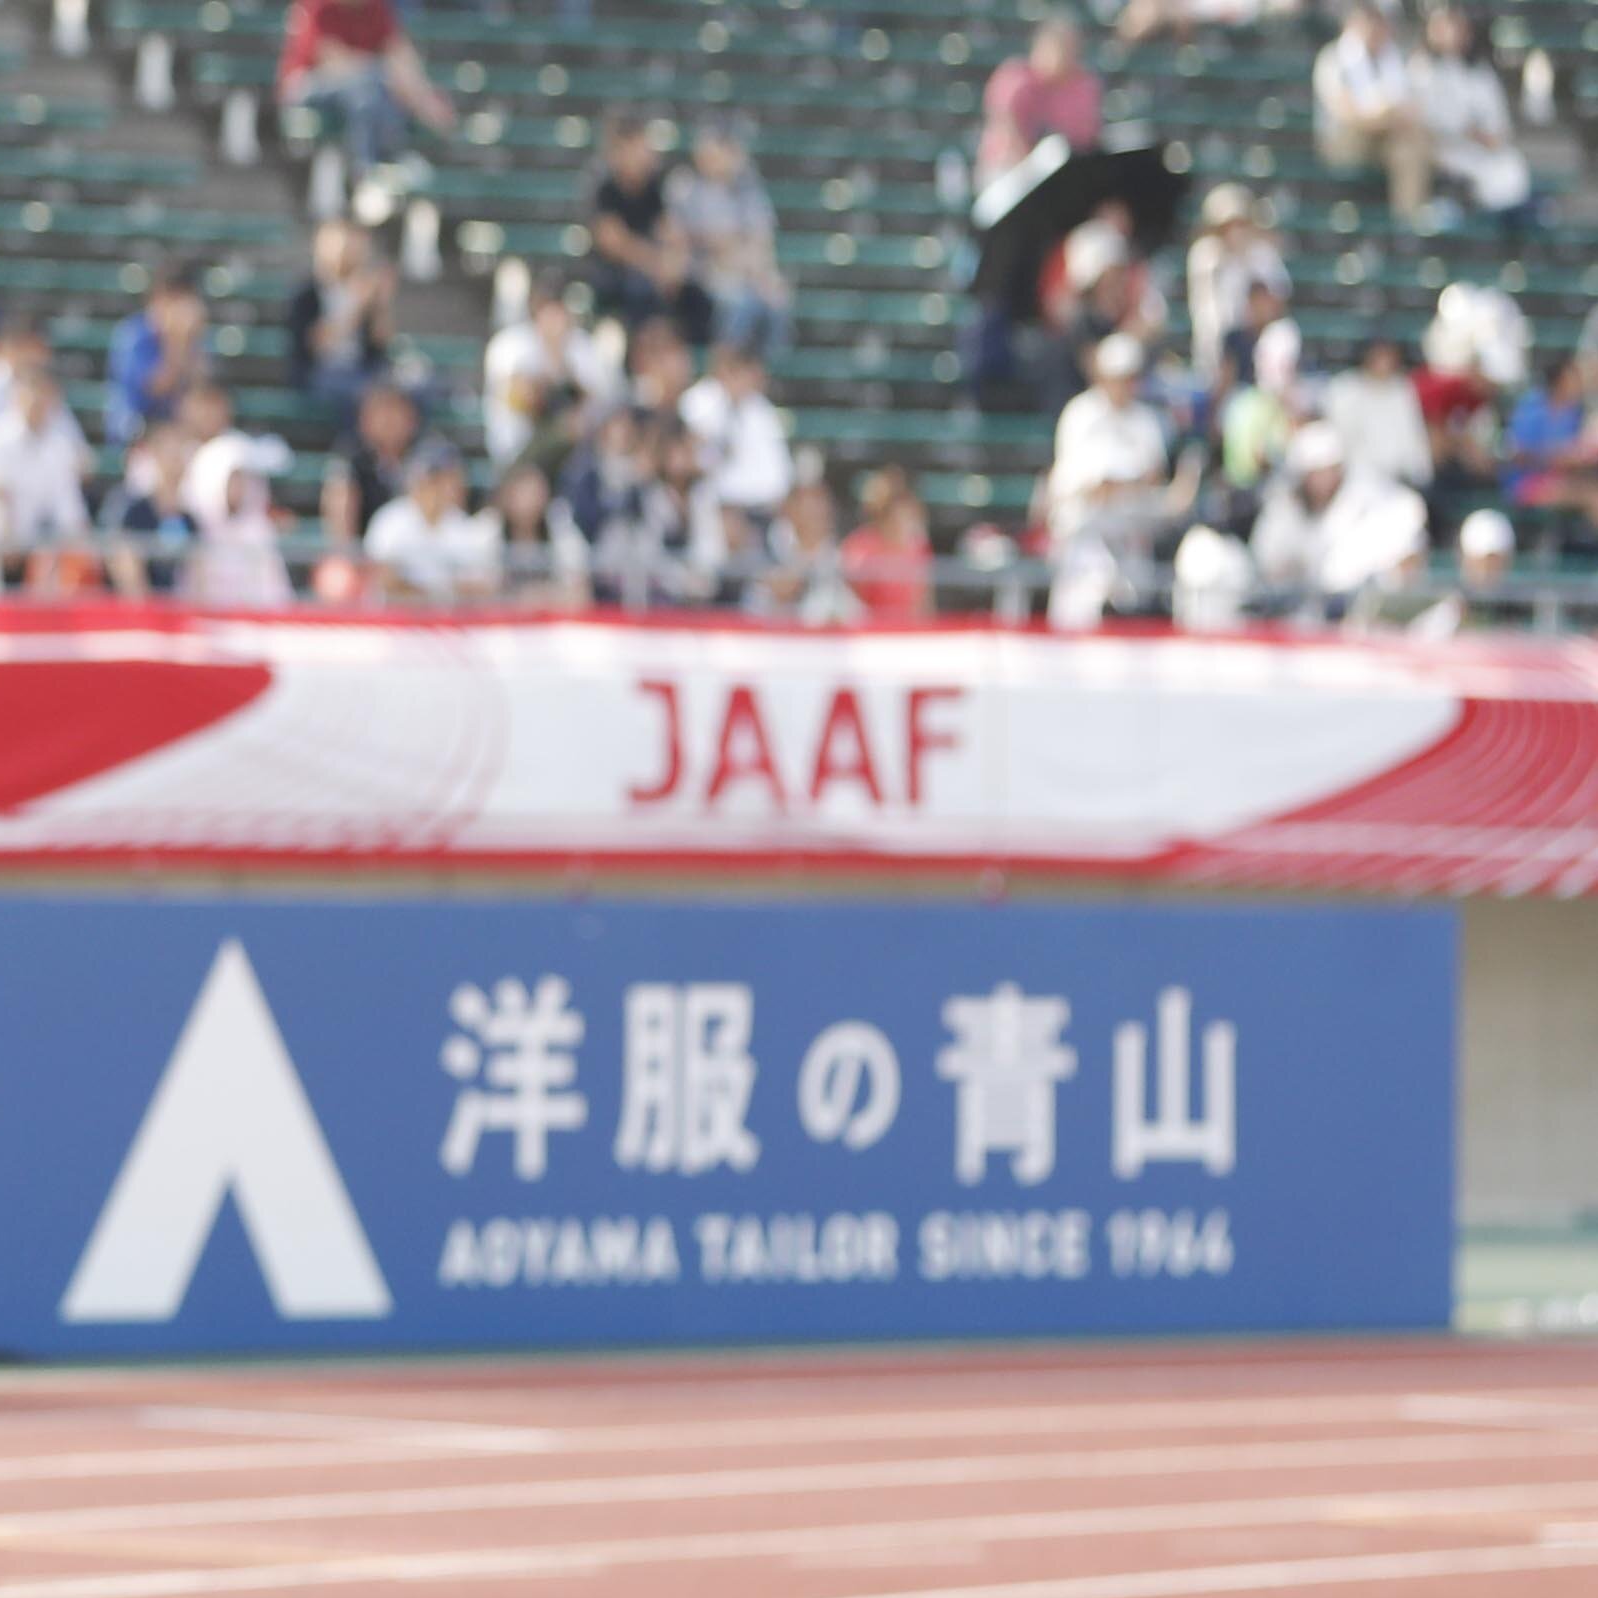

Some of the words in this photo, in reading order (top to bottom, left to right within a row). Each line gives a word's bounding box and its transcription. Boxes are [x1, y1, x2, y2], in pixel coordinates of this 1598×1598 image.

[626, 678, 967, 810] JAAF
[439, 973, 1238, 1185] 洋服の青山
[436, 1213, 681, 1290] AOYAMA
[691, 1210, 900, 1285] TAILOR
[916, 1208, 1094, 1283] SINCE
